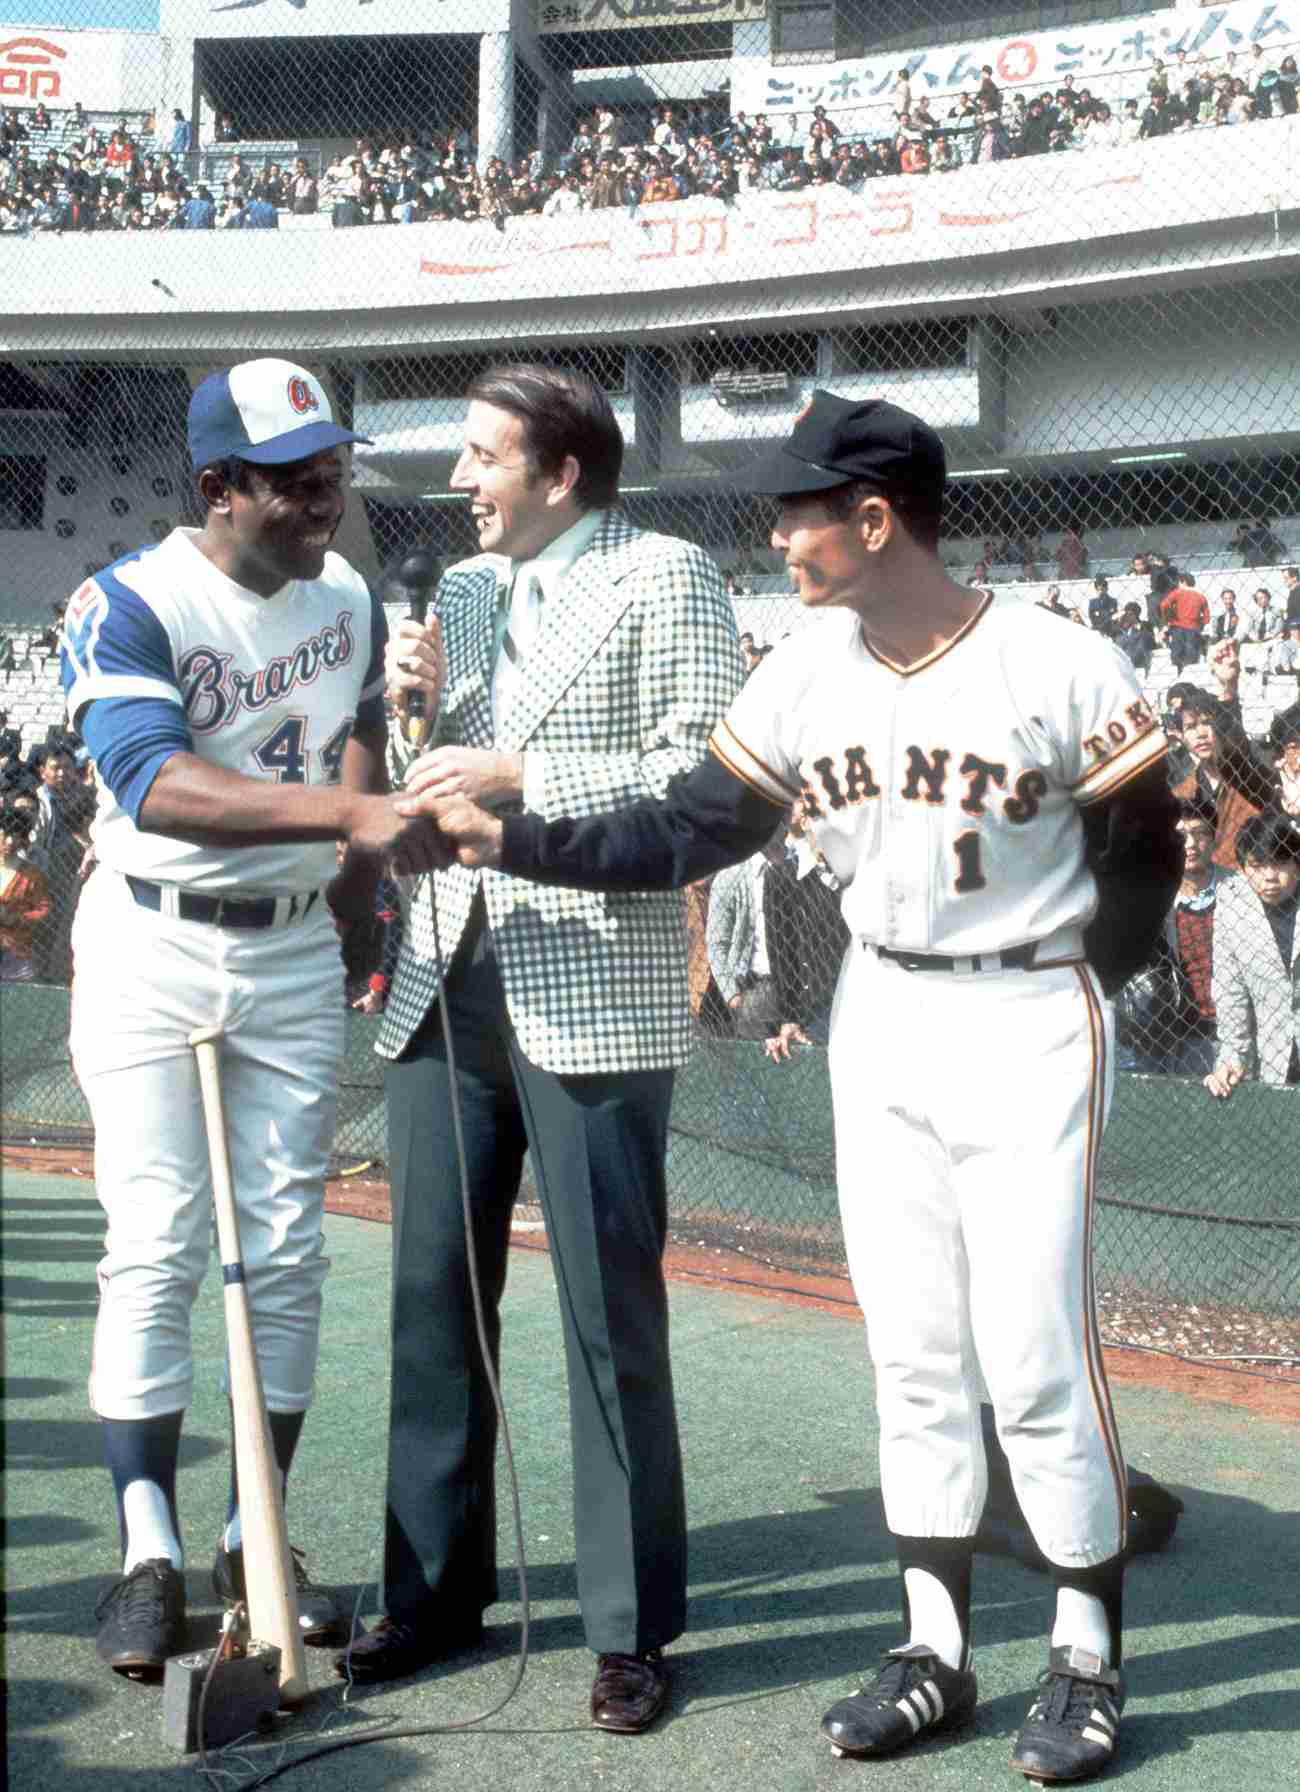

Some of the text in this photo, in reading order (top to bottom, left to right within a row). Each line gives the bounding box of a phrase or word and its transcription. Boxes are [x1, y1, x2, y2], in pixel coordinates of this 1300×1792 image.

[640, 192, 913, 260] コカ・コーラ
[178, 610, 355, 737] Braves
[252, 715, 354, 786] 44
[952, 830, 986, 893] 1
